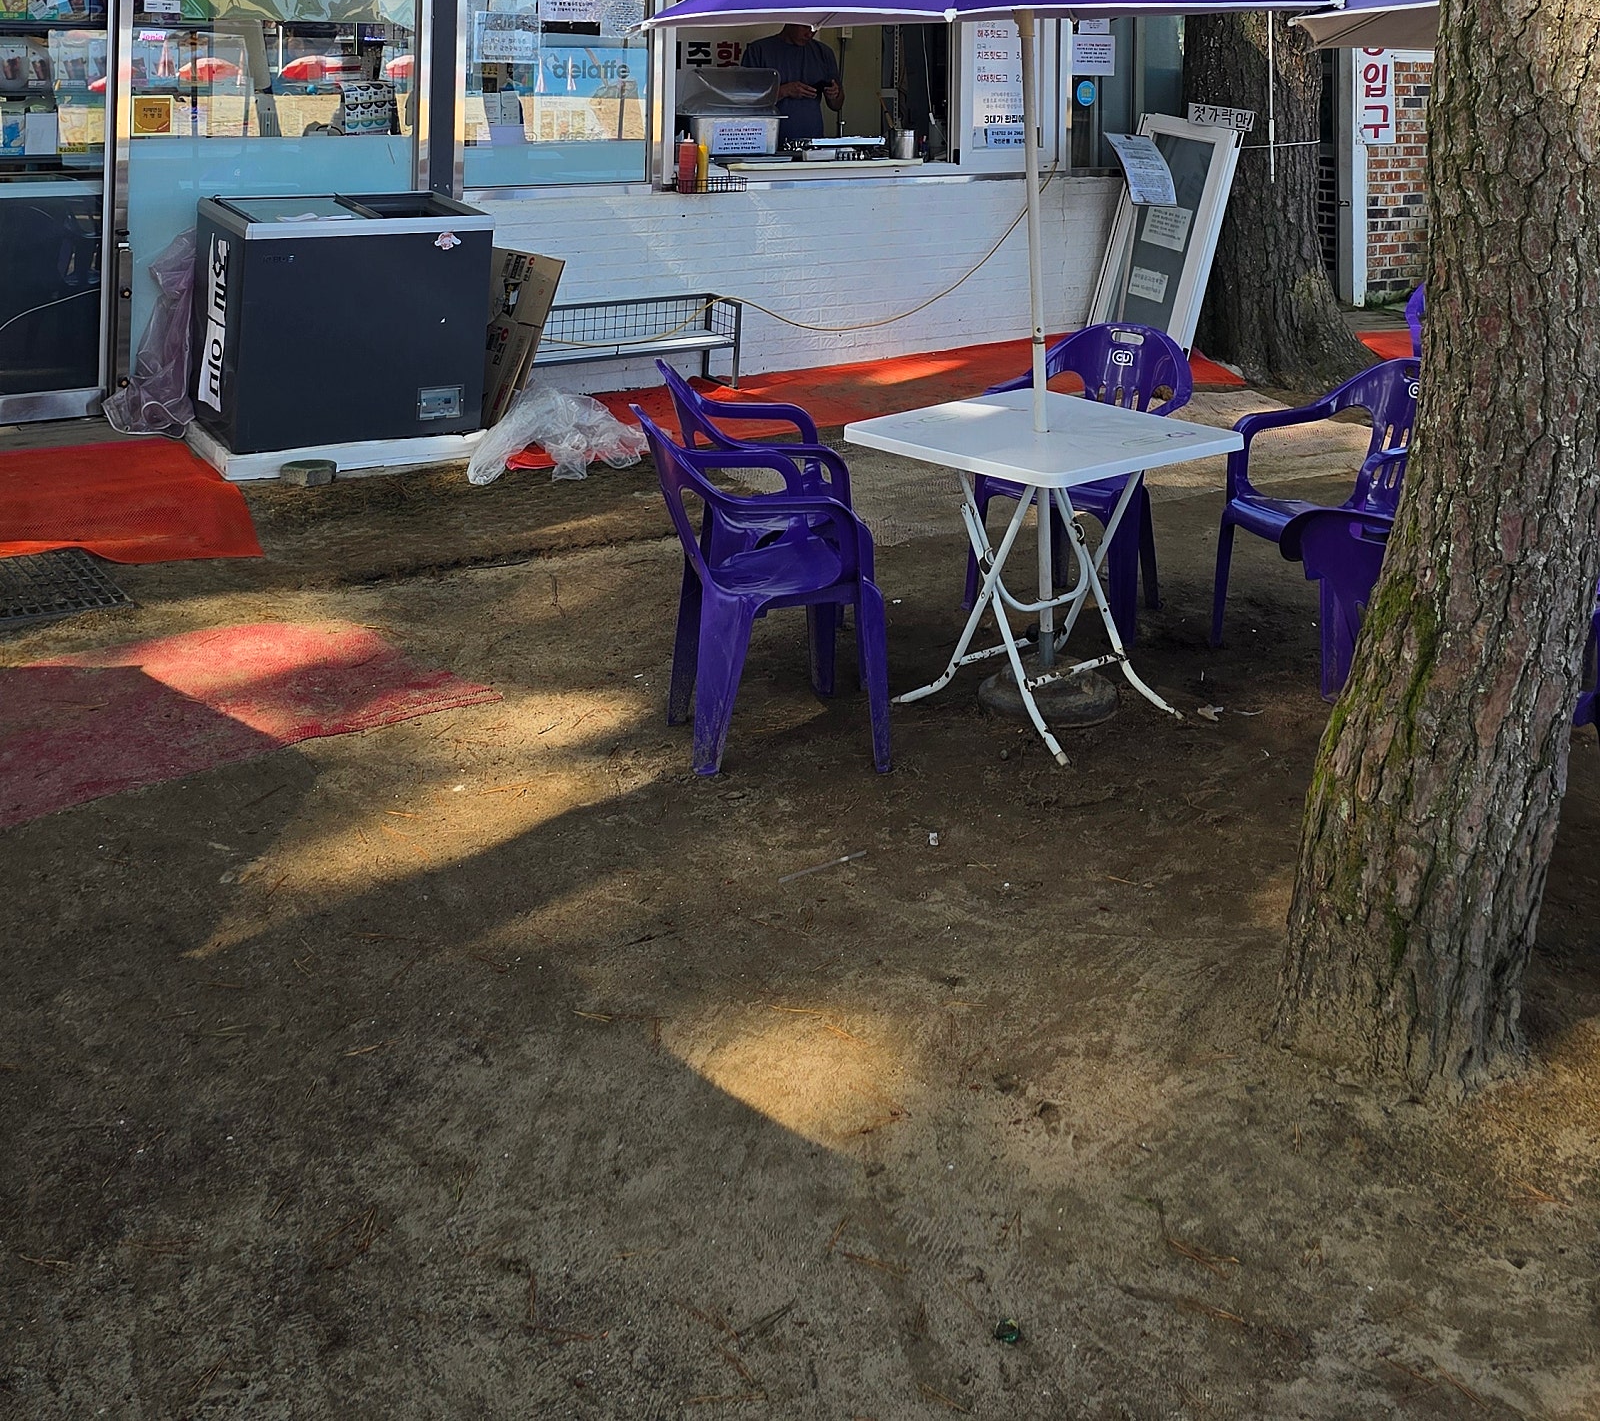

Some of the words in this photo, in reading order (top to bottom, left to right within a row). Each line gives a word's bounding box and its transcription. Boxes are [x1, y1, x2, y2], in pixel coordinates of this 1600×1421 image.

[976, 51, 1009, 60] 치즈핫도그
[553, 58, 631, 80] delaffe
[984, 115, 1003, 124] 3대가
[1194, 105, 1253, 130] 젓가락만!
